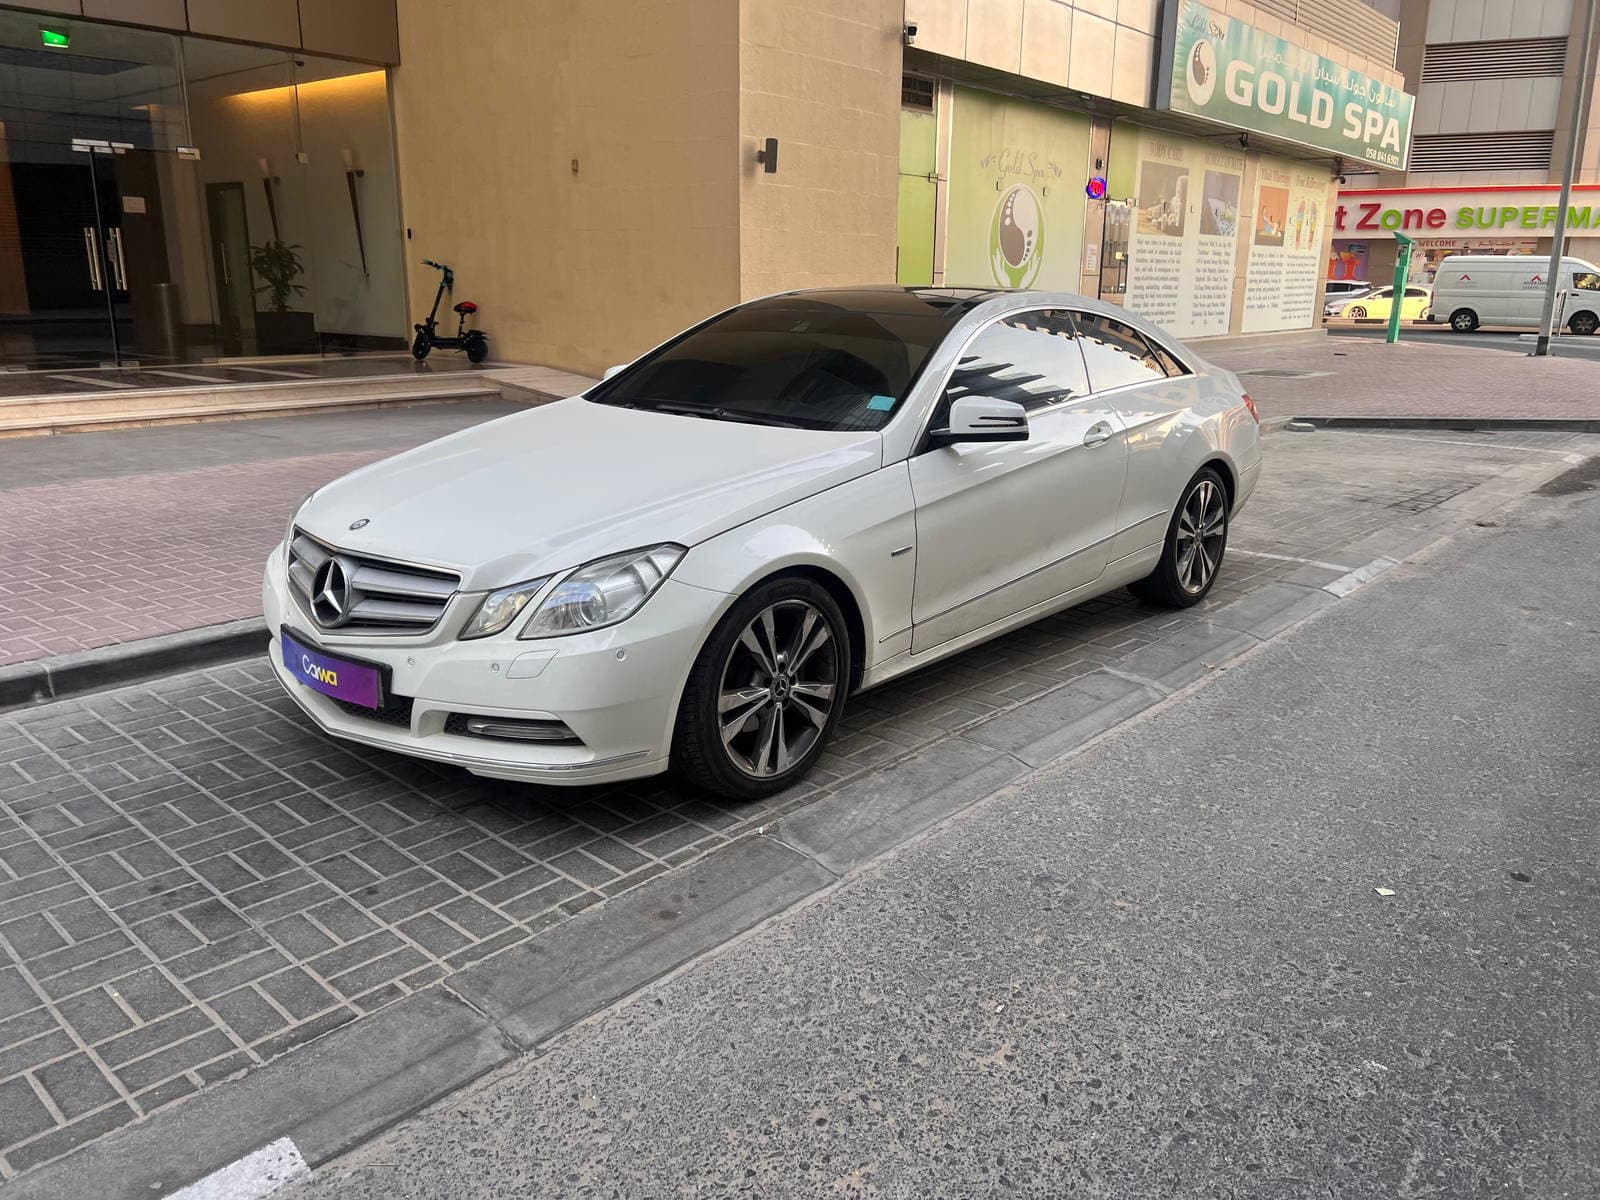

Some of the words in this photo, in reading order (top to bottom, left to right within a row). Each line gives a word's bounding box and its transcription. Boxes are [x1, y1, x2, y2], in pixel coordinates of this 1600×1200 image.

[1224, 59, 1334, 129] GOLD
[1343, 103, 1400, 153] SPA
[1356, 202, 1447, 231] Zone
